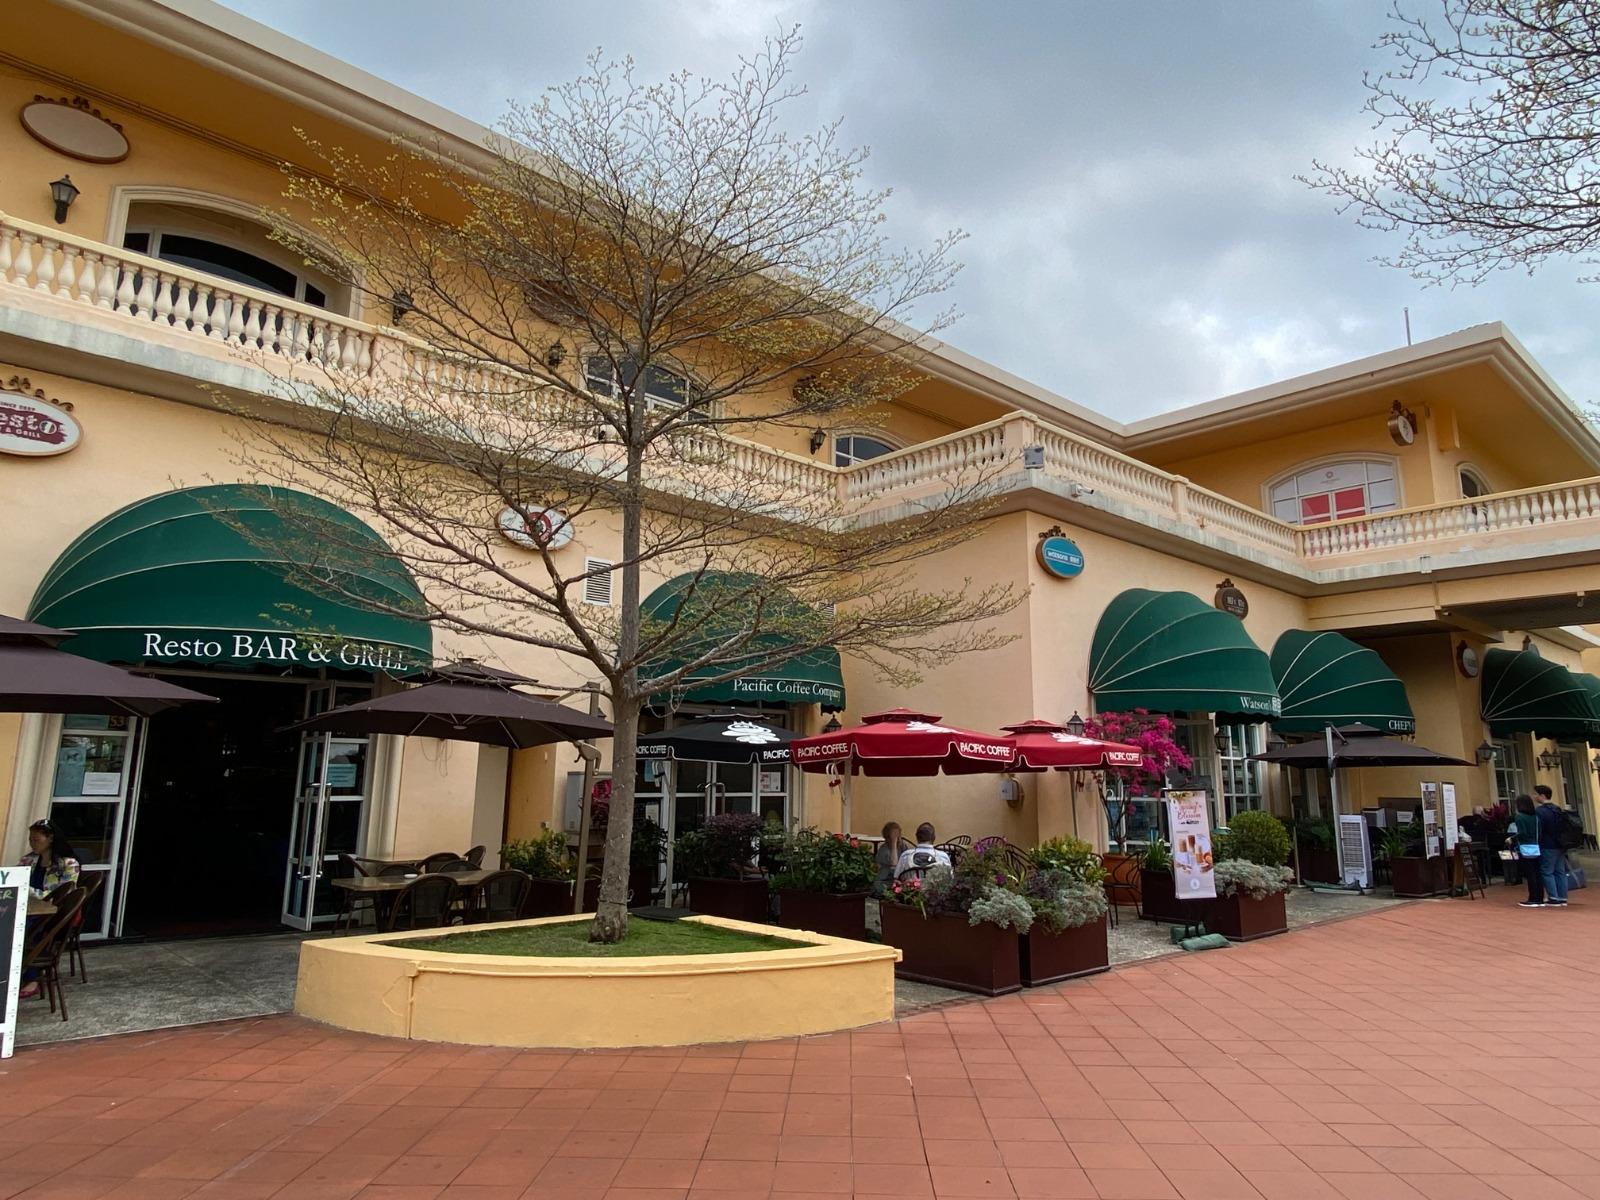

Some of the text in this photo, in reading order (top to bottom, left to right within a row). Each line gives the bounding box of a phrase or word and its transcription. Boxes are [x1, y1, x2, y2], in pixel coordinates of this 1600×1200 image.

[143, 633, 409, 671] Resto BAR & GRILL
[733, 679, 841, 702] Pacific Coffee Company
[763, 749, 790, 760] PACIFIC
[797, 742, 848, 758] PACIFIC COFFEE
[960, 741, 1010, 757] PACIFIC COFFEE
